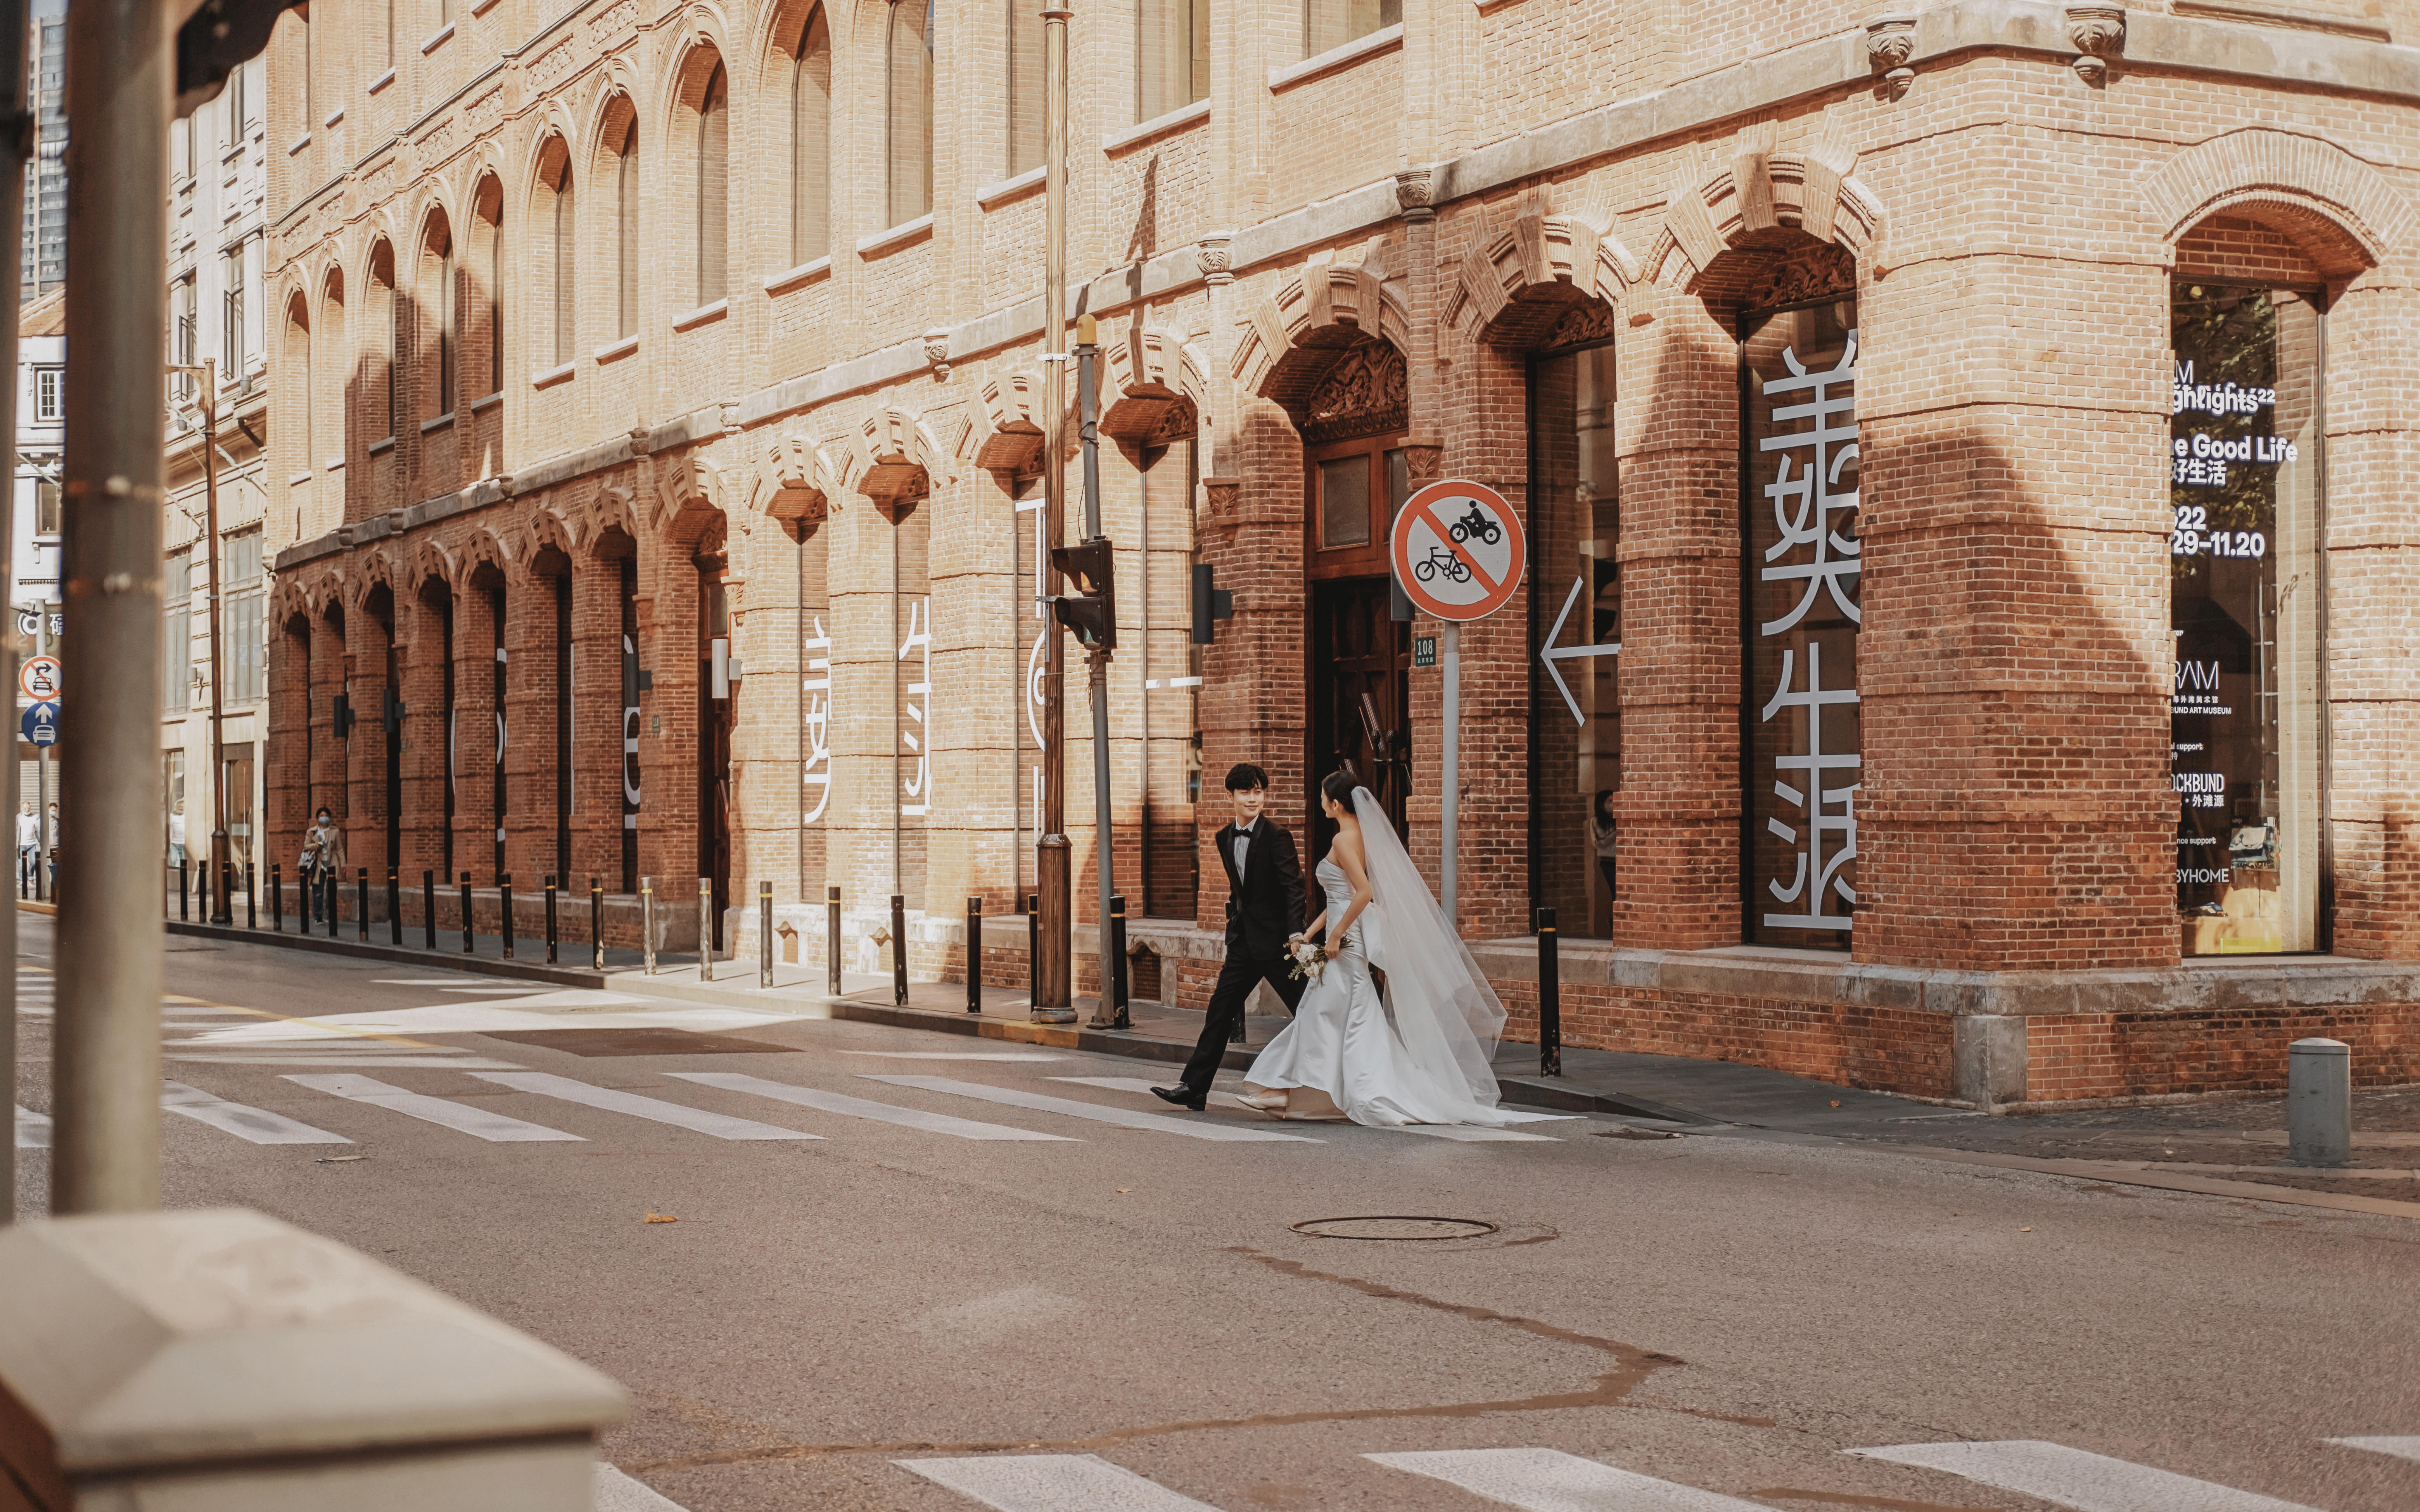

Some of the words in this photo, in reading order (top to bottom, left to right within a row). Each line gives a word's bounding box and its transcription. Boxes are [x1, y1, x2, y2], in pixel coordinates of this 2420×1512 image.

[2194, 433, 2251, 460] Good
[2257, 437, 2298, 462] Life
[1417, 639, 1433, 656] 108
[2176, 742, 2203, 751] support
[2190, 837, 2216, 845] support
